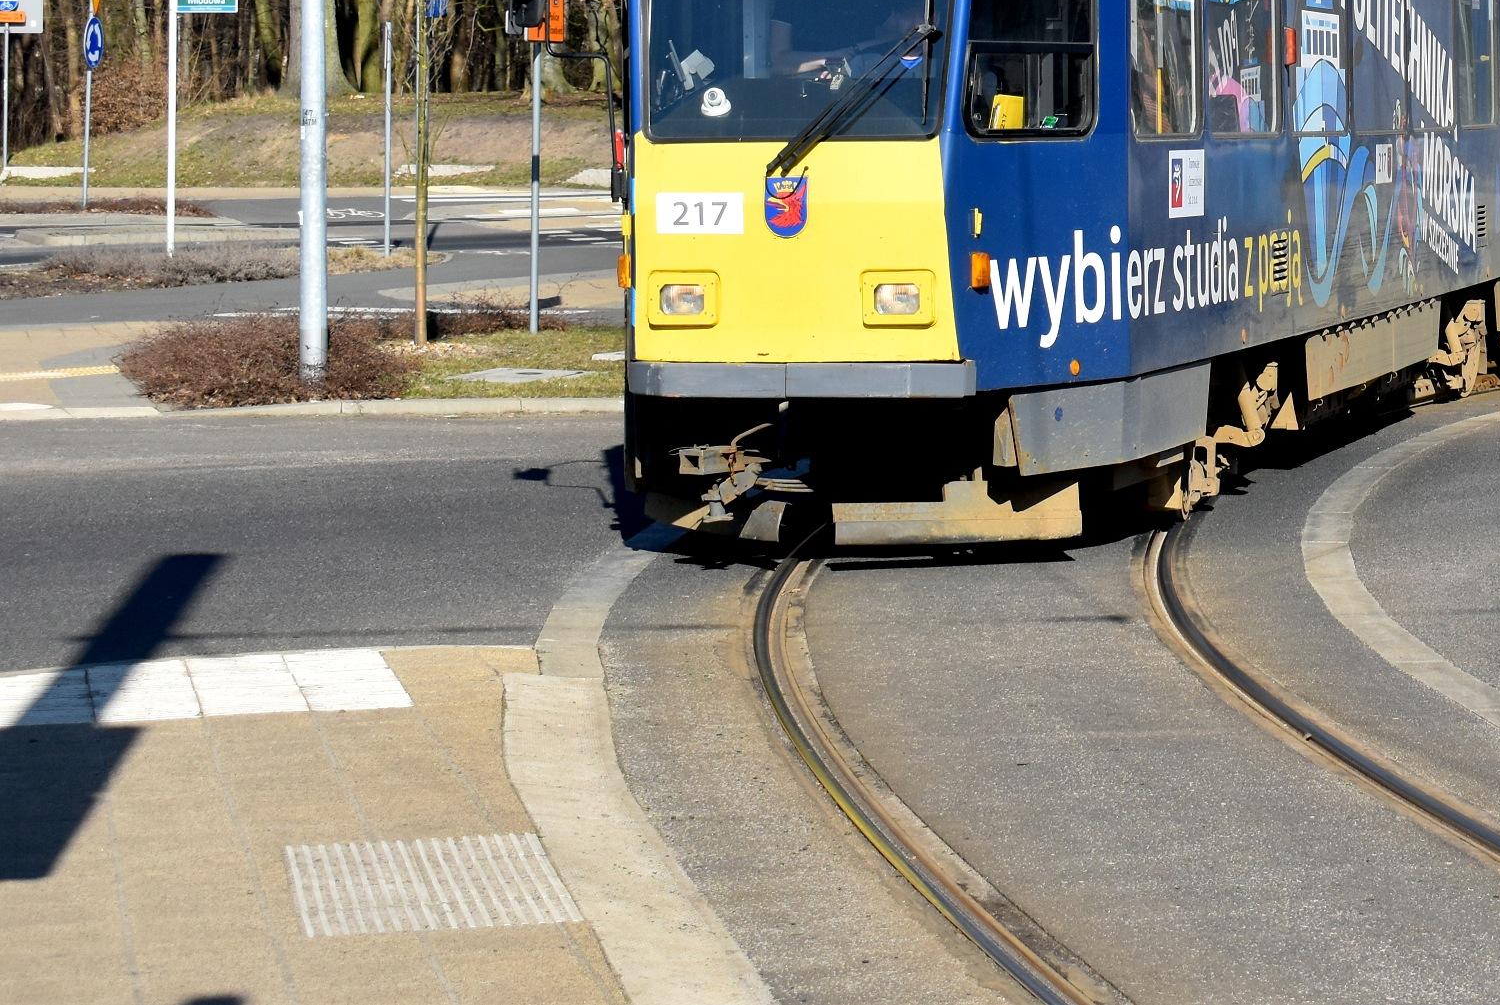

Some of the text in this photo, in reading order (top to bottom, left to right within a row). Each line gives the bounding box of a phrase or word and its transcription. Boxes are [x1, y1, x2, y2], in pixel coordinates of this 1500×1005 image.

[1377, 152, 1388, 176] 217
[1423, 120, 1477, 253] MORSKA
[673, 201, 728, 226] 217
[1428, 219, 1459, 276] SZCZECINIE
[989, 224, 1166, 349] wybierz
[1172, 215, 1239, 312] studia
[1244, 236, 1254, 298] z
